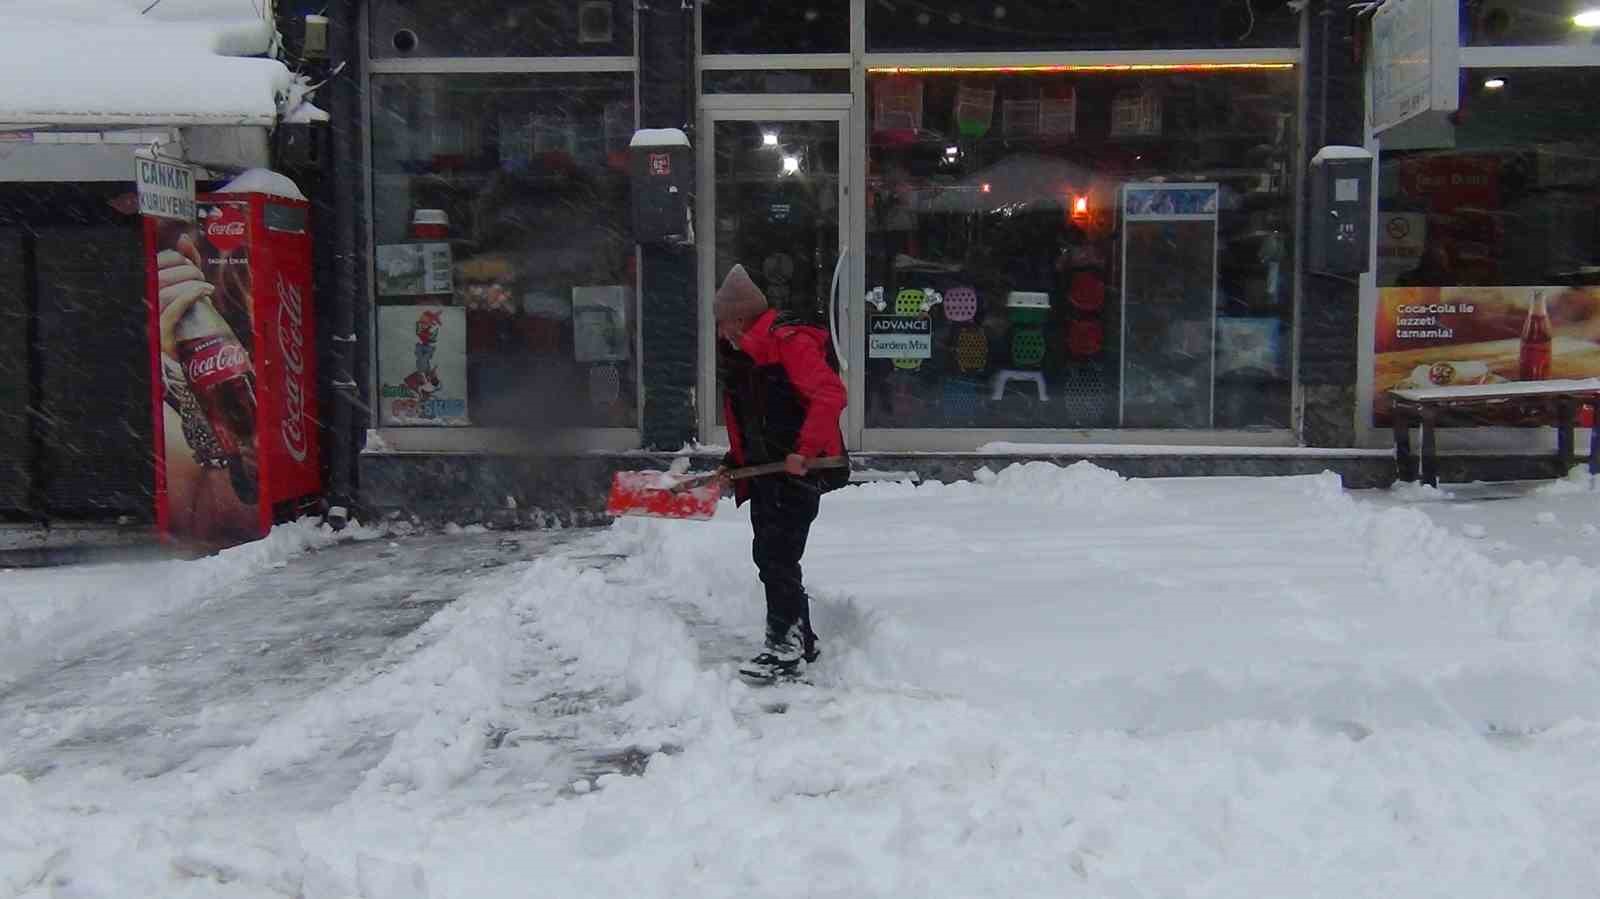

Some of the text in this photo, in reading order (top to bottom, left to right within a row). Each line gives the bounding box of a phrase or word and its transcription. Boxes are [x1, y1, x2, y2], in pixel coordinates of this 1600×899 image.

[208, 222, 245, 236] Coca-Cola
[1397, 303, 1474, 313] Coca-Cola ile
[873, 320, 928, 330] ADVANCE
[1396, 315, 1436, 326] lezzeti
[1396, 328, 1453, 338] tamamla!
[871, 339, 928, 350] Garden Mix
[189, 344, 246, 382] Coca-Cola
[278, 272, 306, 462] Coca-Cola
